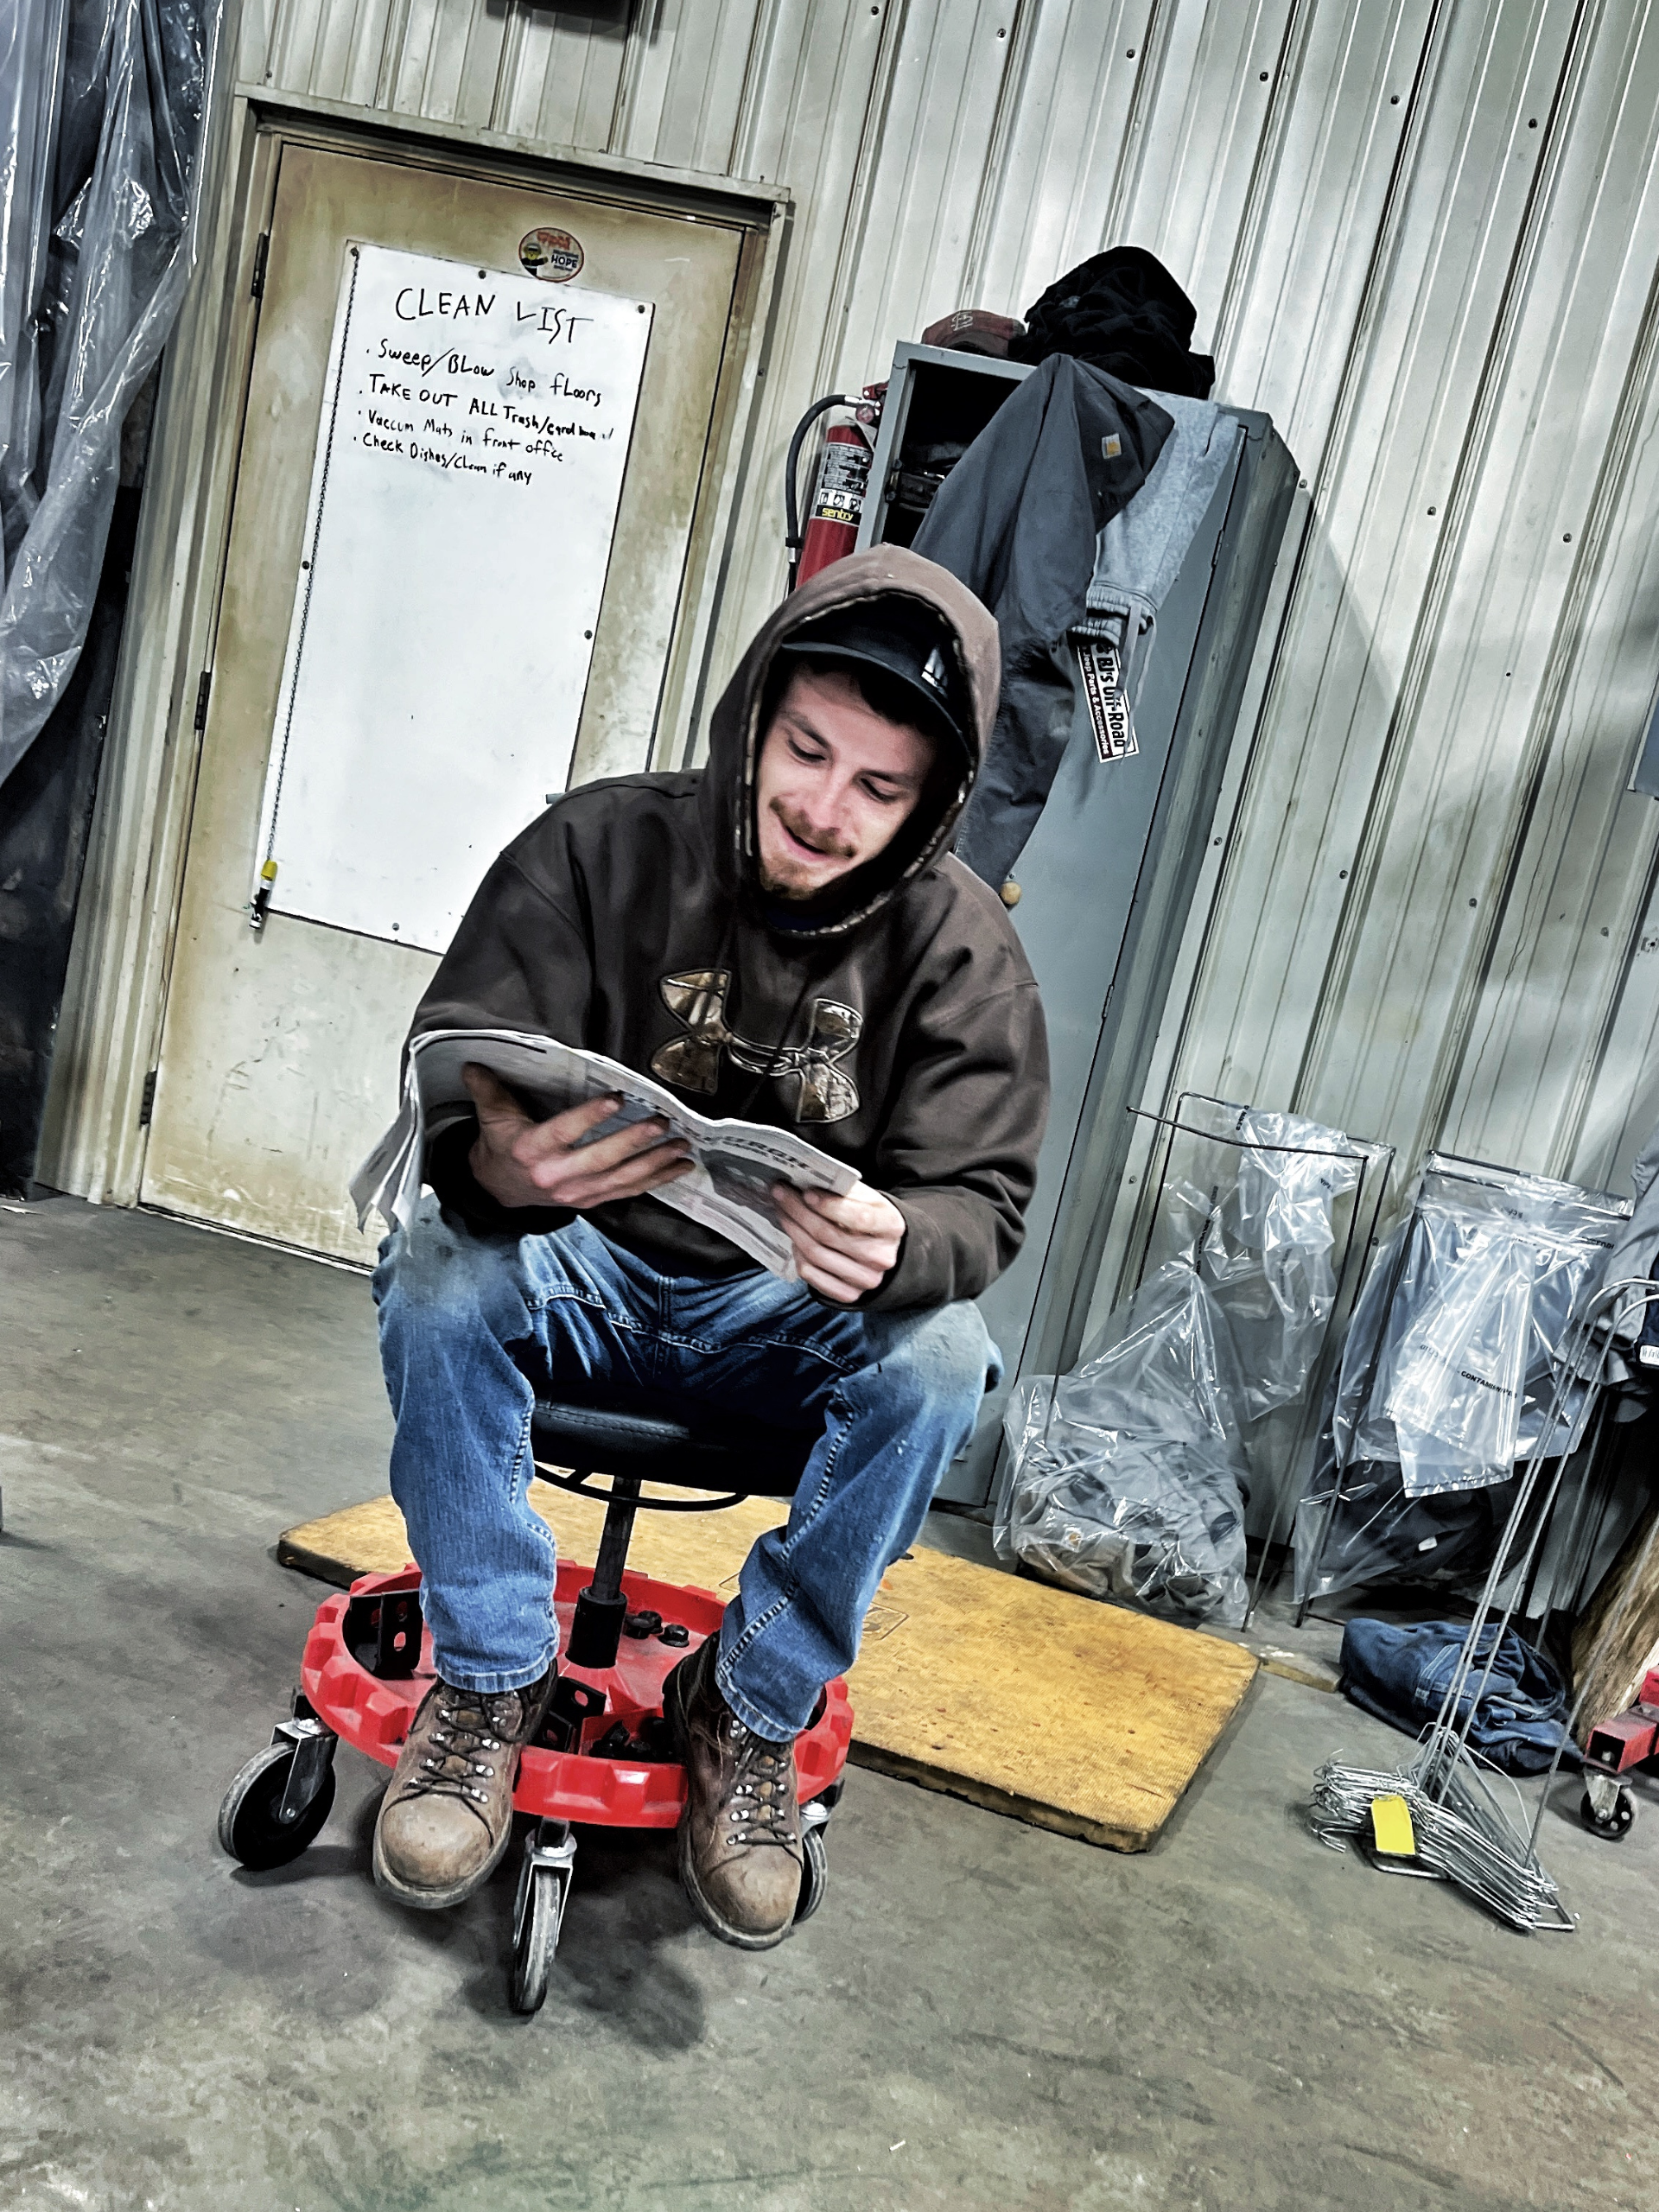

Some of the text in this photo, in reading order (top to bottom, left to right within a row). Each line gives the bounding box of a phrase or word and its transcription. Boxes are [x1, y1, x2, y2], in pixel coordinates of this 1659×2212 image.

[551, 255, 578, 268] HOPE
[396, 289, 594, 344] CLEAN LIST
[369, 374, 410, 400] TAKE
[419, 390, 458, 407] OUT
[469, 397, 498, 416] ALL
[505, 366, 536, 393] Shop
[423, 419, 453, 437] Mats
[461, 430, 472, 445] in
[482, 428, 522, 450] front
[363, 432, 404, 453] Check
[493, 462, 506, 478] if
[509, 471, 531, 486] any
[822, 507, 854, 522] sentry
[1096, 657, 1116, 683] BJ's
[1087, 673, 1096, 696] Parts
[1094, 704, 1110, 754] Accessories
